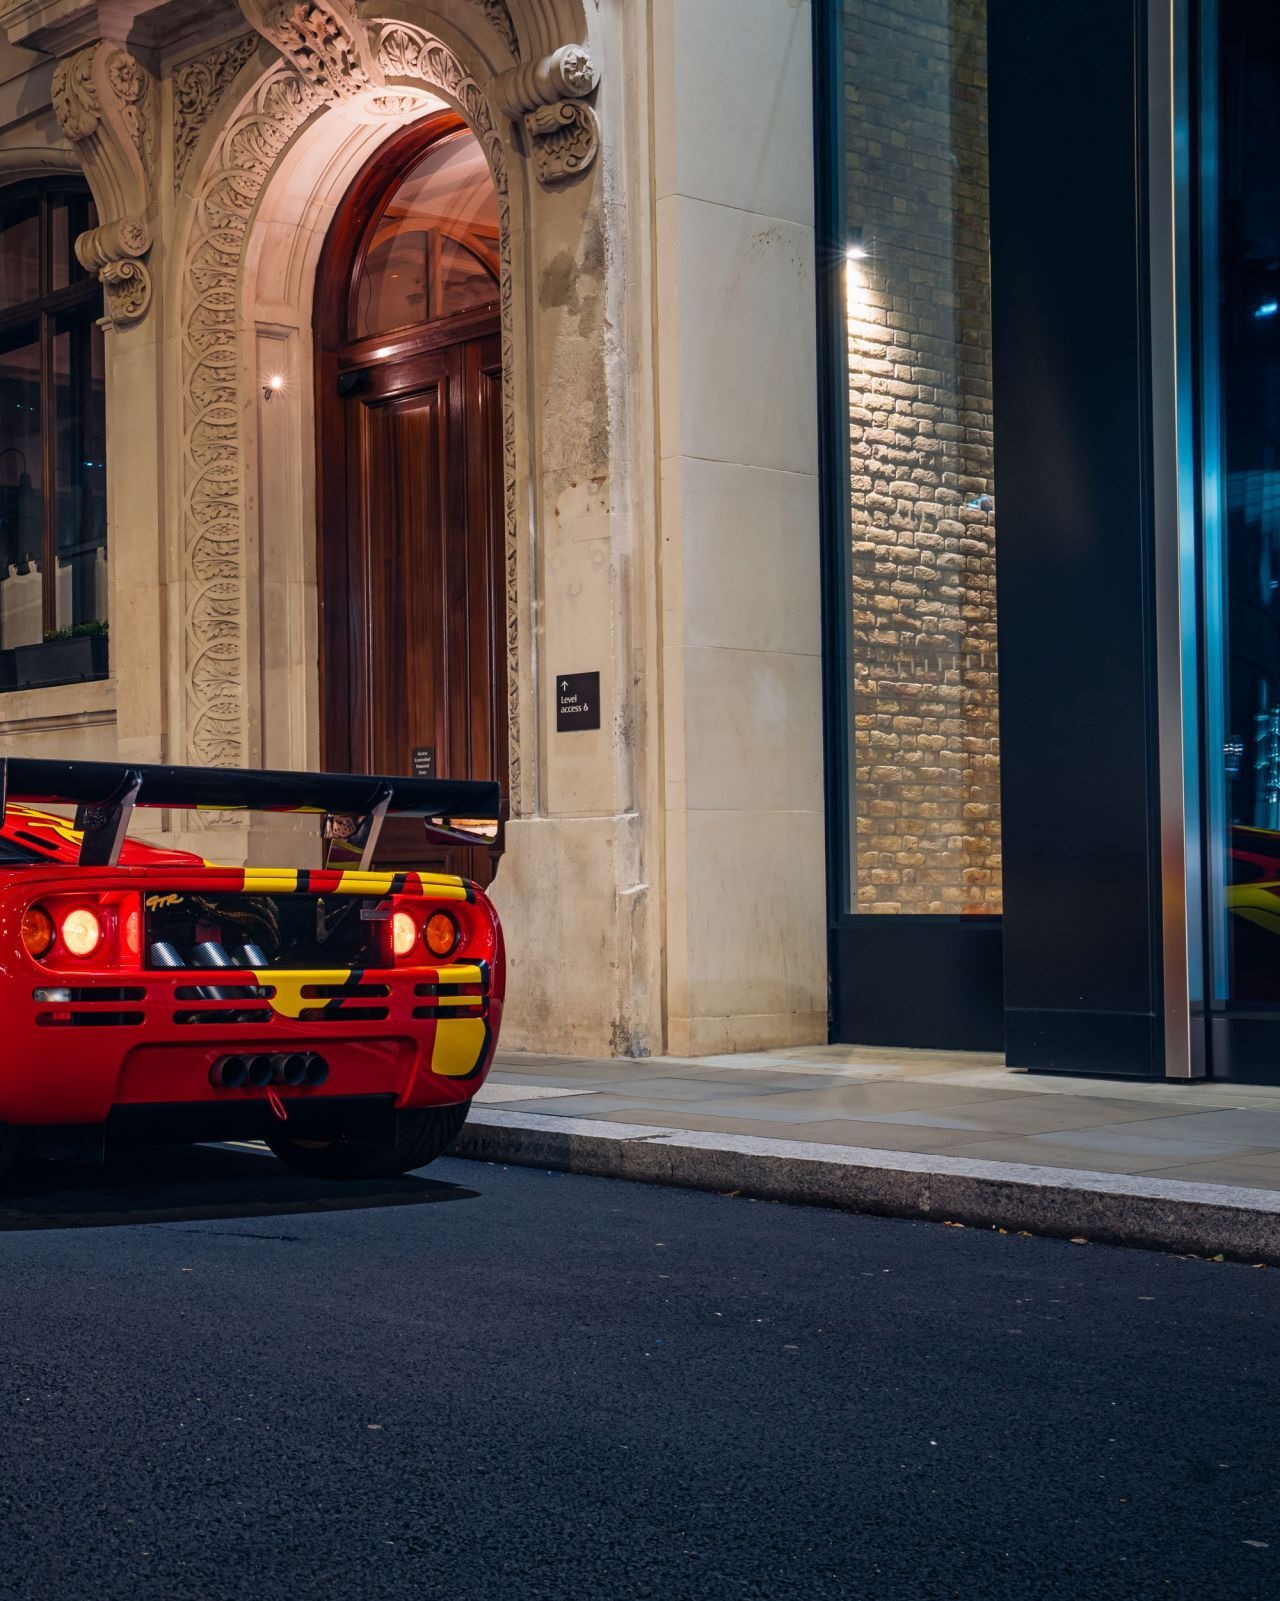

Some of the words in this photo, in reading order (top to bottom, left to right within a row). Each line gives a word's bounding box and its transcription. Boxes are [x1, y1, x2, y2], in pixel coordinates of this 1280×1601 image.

[560, 694, 578, 704] Level
[560, 705, 582, 714] access
[145, 893, 184, 912] GTR
